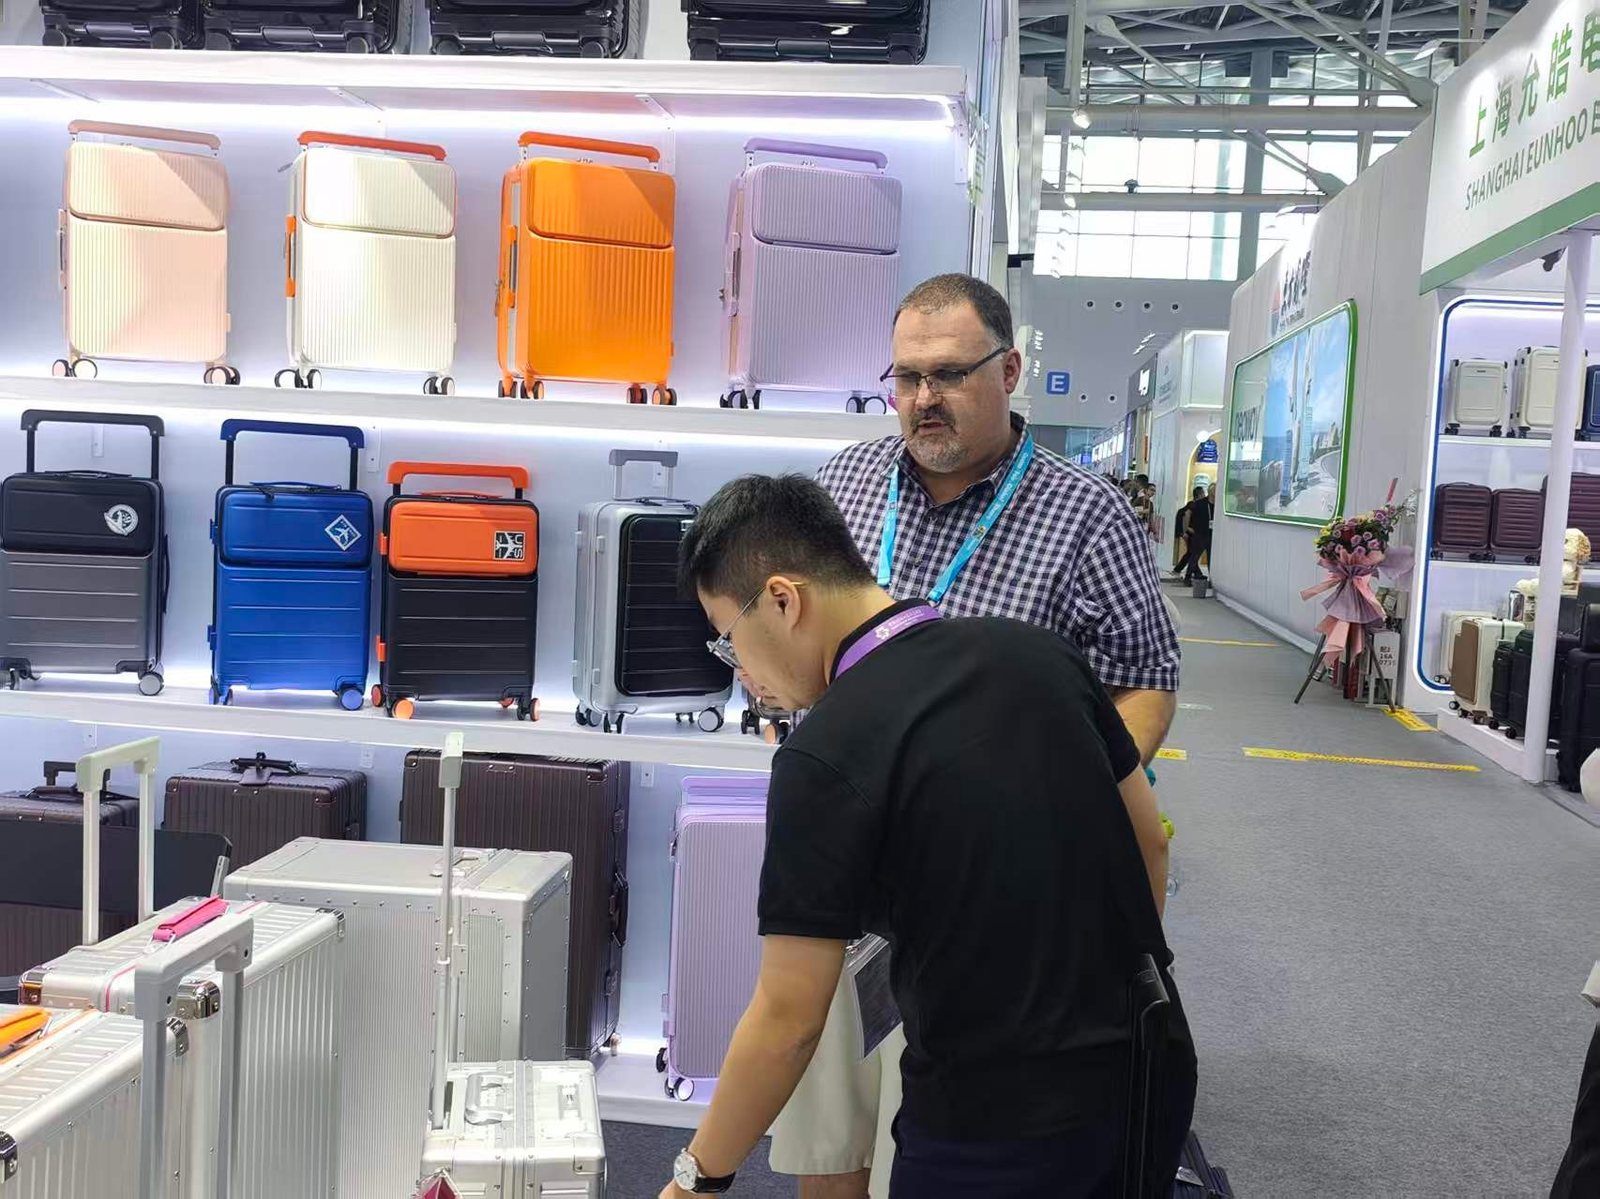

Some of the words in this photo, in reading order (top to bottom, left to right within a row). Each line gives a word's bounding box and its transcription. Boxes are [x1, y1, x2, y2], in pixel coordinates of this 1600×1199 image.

[1465, 149, 1525, 210] SHANGHAI
[1526, 107, 1588, 174] EUNHOO
[1051, 375, 1065, 392] E
